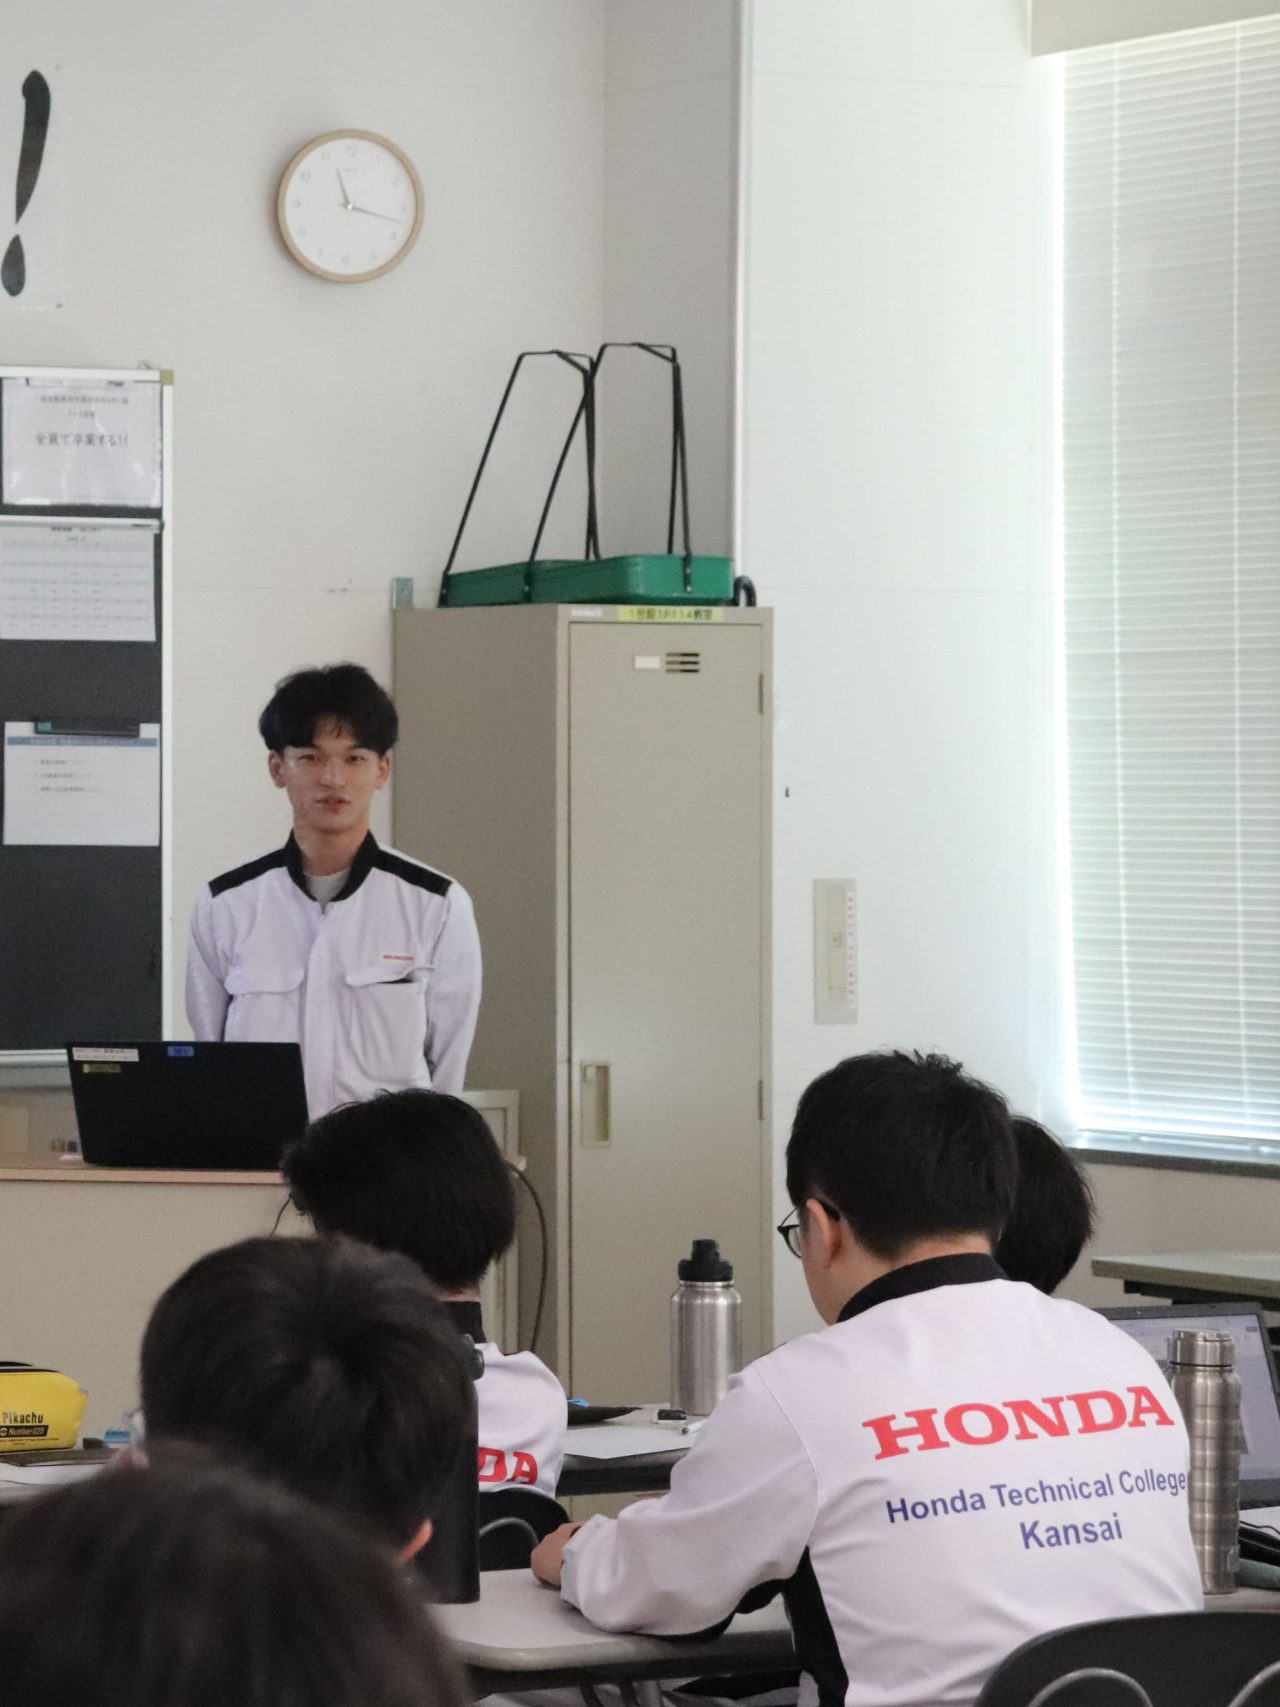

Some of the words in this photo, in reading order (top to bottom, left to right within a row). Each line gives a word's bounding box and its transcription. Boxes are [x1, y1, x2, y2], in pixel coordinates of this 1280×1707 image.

[2, 1411, 44, 1425] Pikachu
[862, 1386, 1175, 1461] HONDA
[887, 1489, 986, 1524] Honda
[990, 1473, 1114, 1508] Technical
[1120, 1468, 1187, 1496] College
[1020, 1512, 1123, 1549] Kansai
